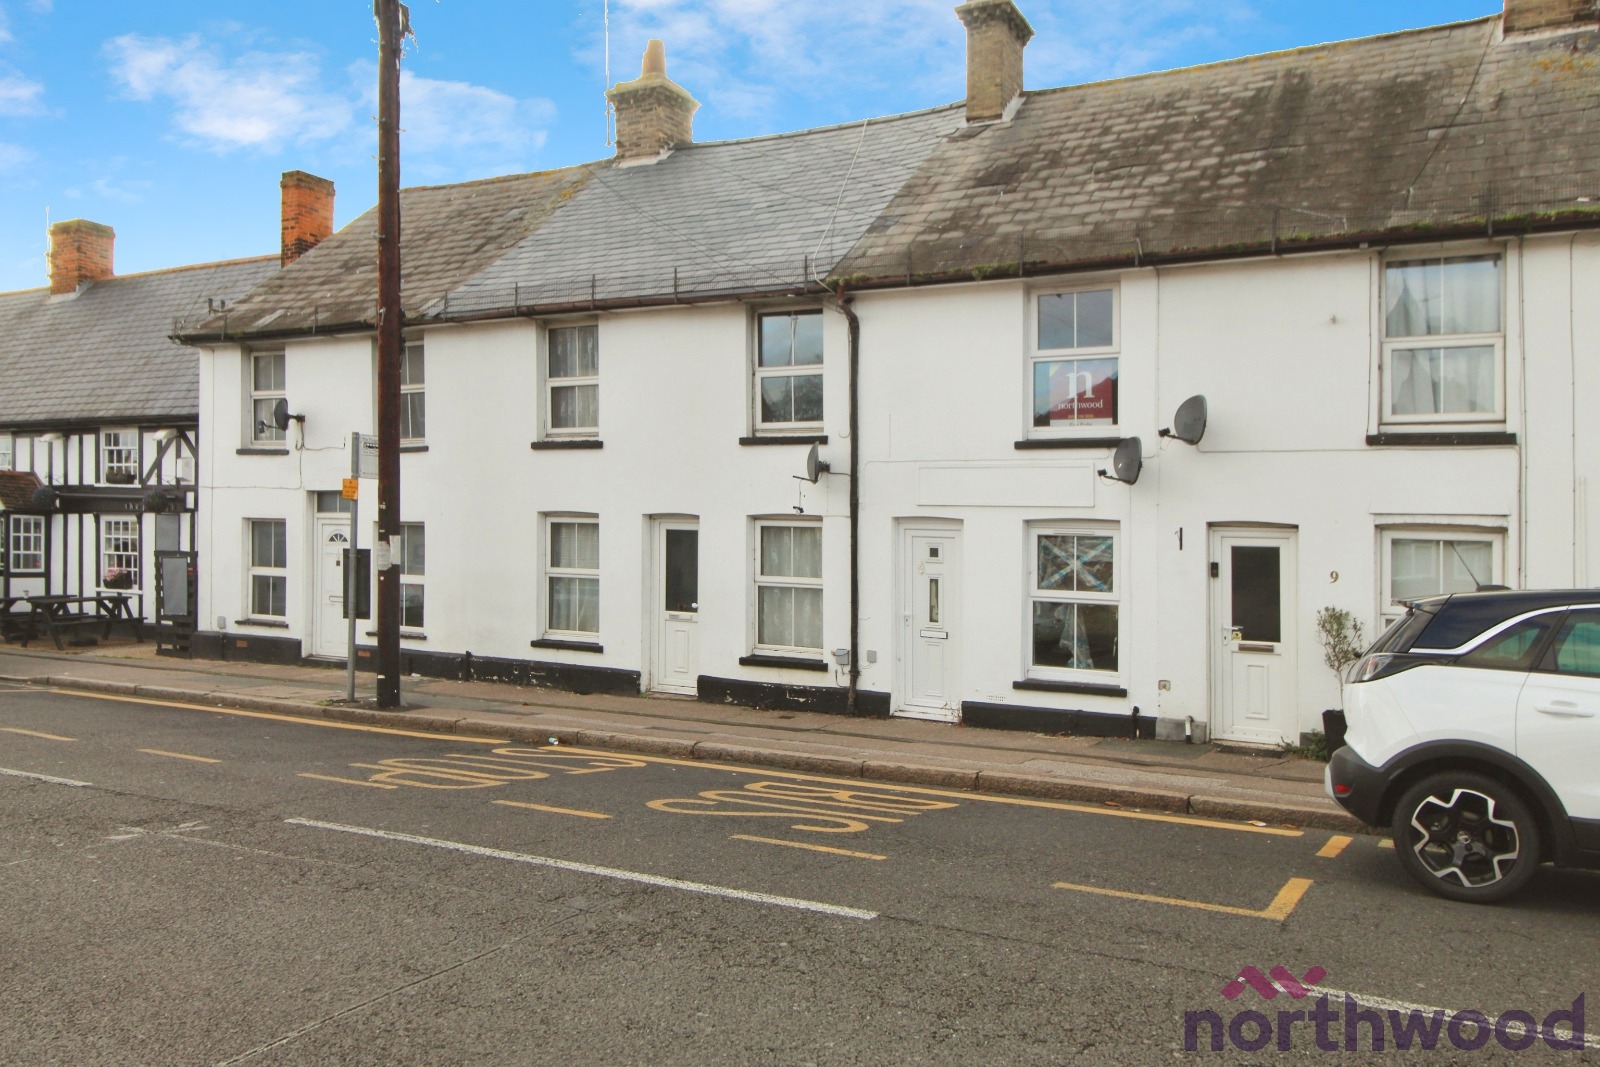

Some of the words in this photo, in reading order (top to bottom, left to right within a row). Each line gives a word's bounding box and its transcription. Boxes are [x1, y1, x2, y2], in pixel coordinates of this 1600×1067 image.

[1066, 371, 1095, 399] n
[1330, 570, 1339, 584] 9
[348, 747, 647, 790] STOP
[646, 782, 960, 834] BUS
